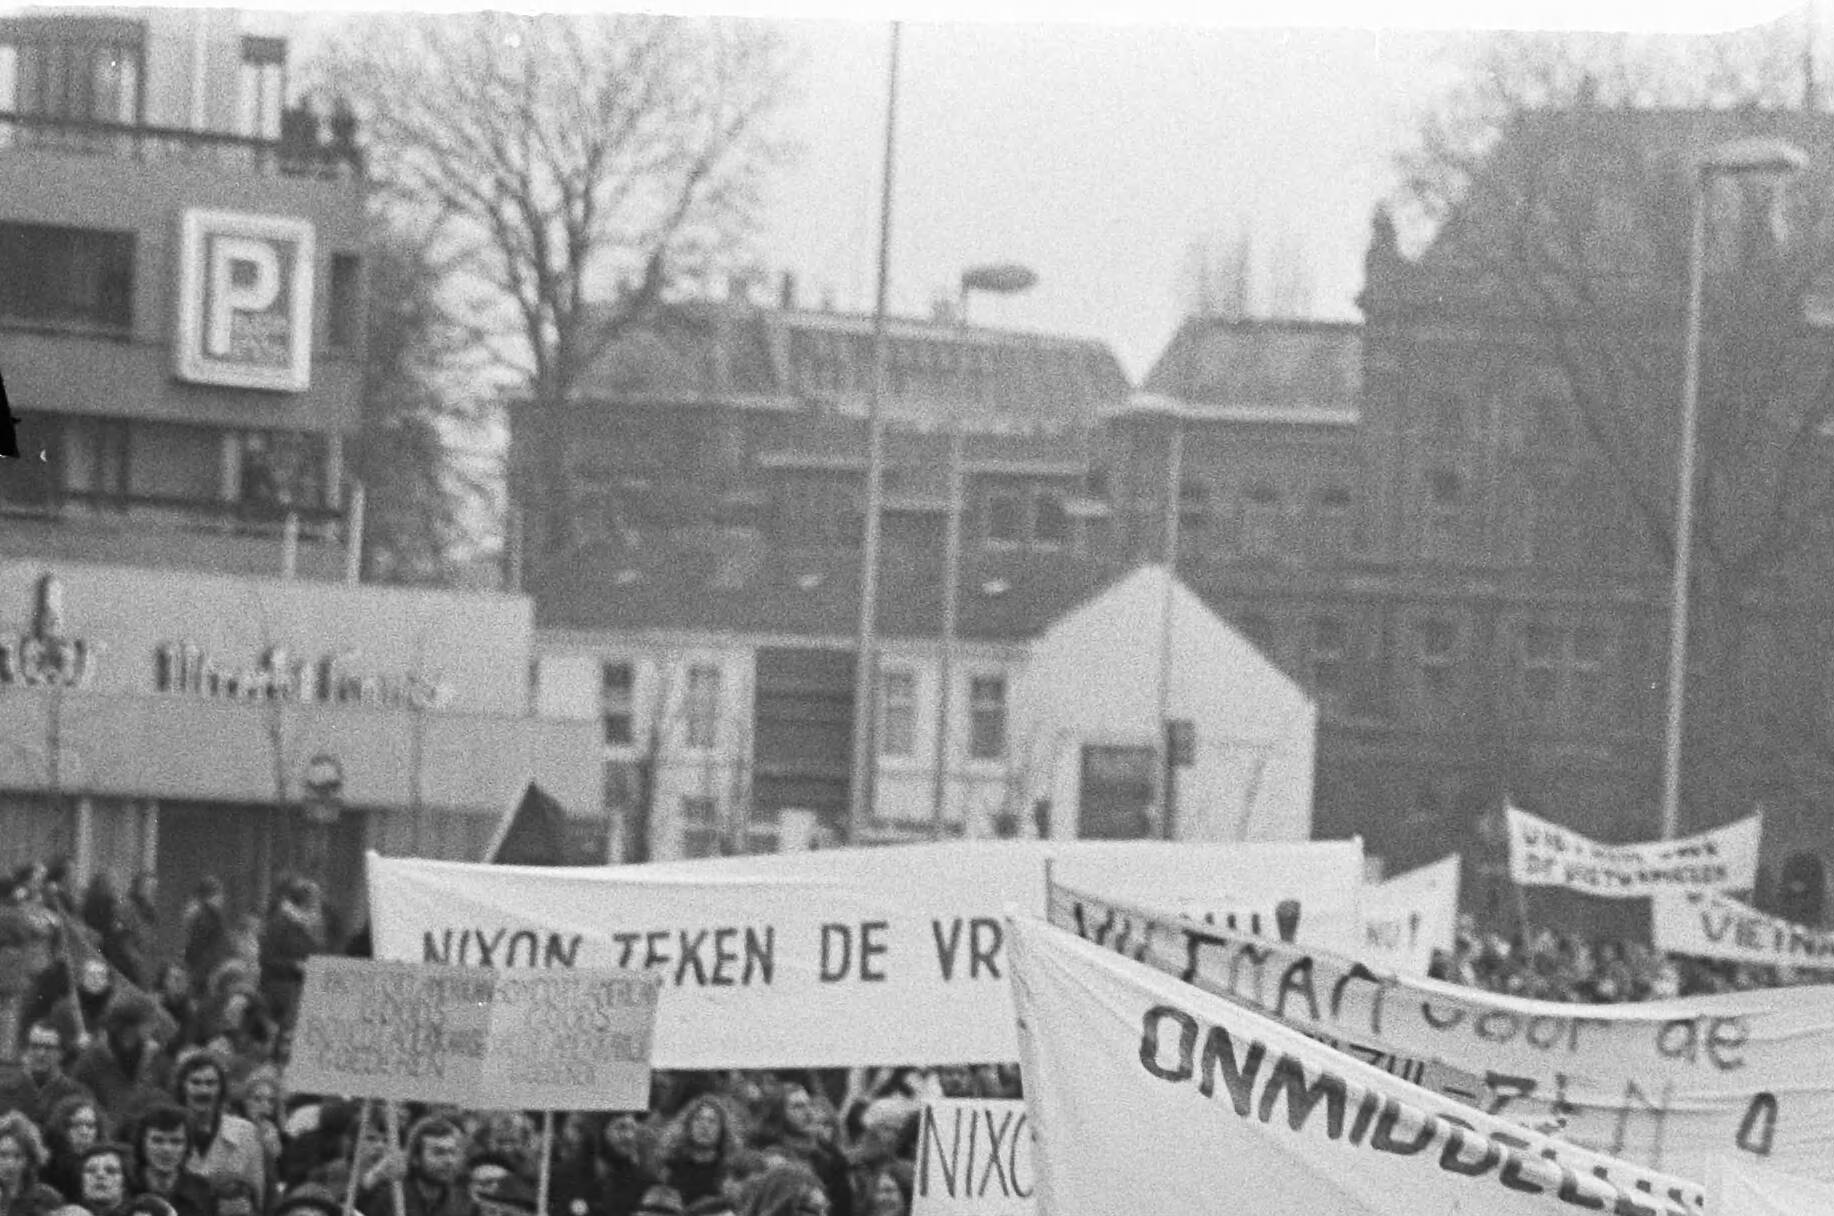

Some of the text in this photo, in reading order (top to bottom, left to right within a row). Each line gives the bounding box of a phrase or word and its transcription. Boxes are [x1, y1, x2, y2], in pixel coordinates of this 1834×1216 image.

[209, 238, 281, 354] P
[422, 928, 583, 968] NIXON
[613, 925, 775, 987] TEKEN
[820, 920, 889, 983] DE
